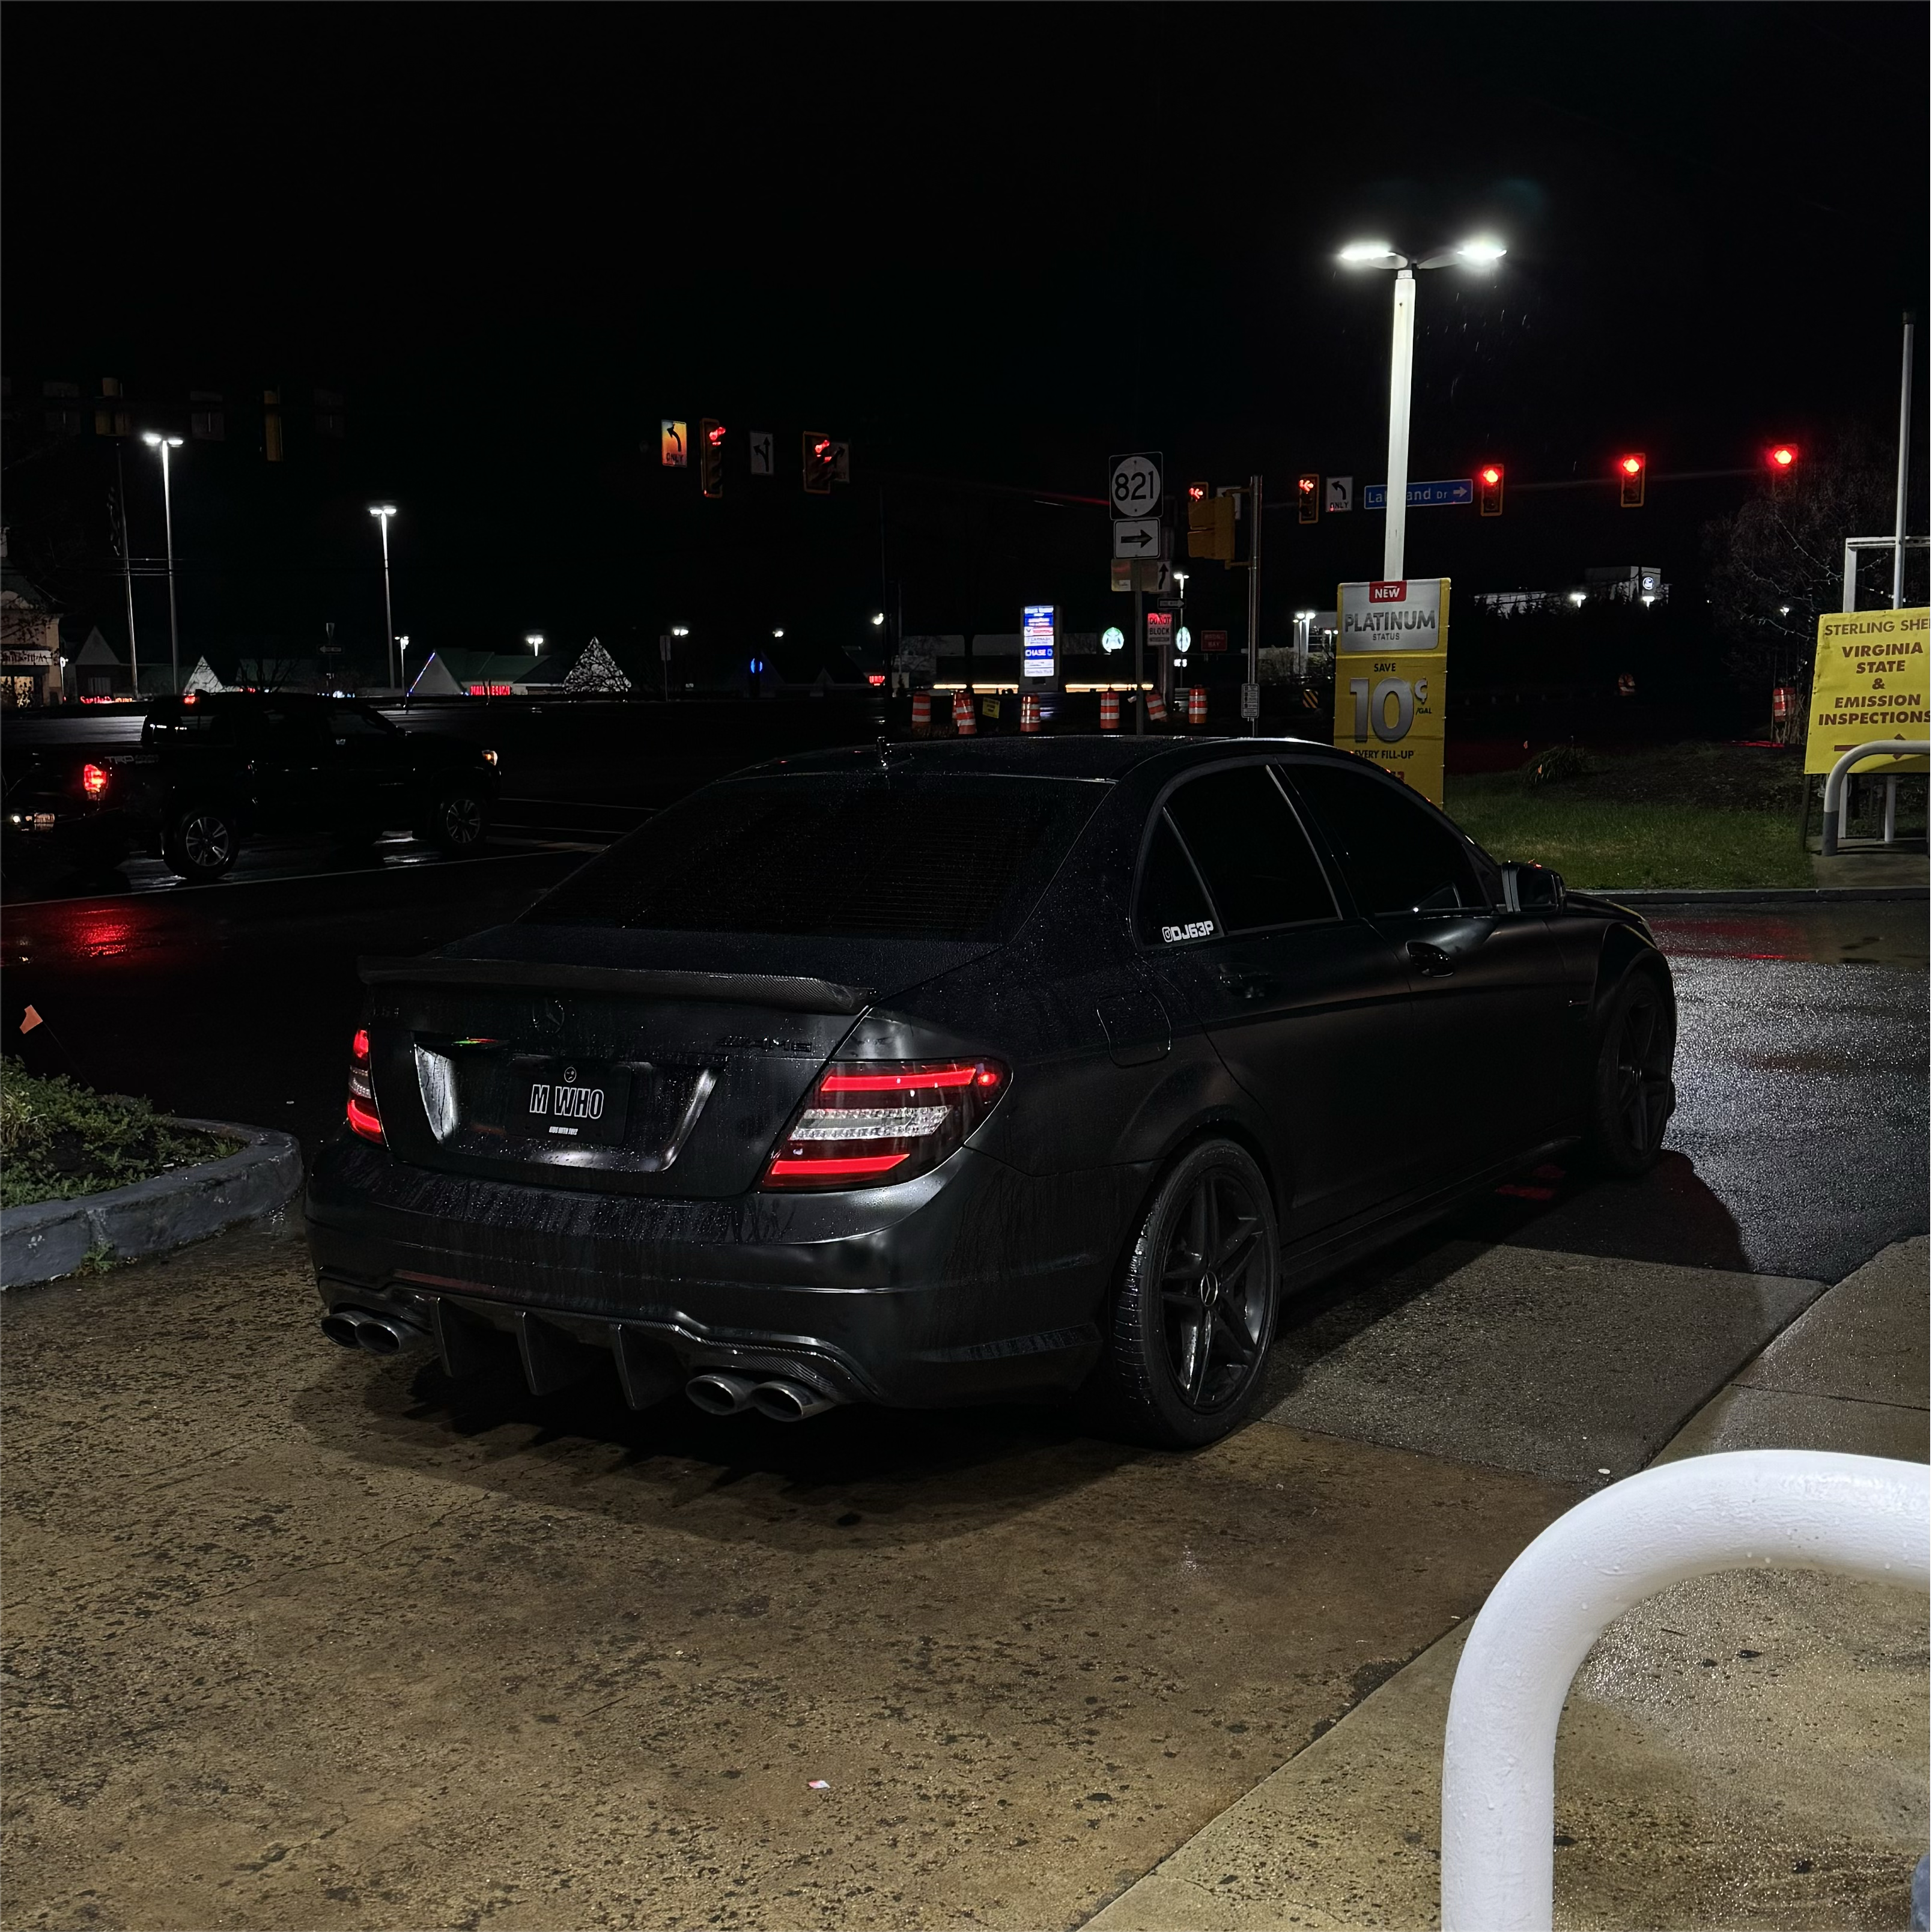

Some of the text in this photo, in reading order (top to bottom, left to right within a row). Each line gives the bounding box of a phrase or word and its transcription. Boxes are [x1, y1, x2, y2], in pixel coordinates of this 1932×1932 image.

[666, 452, 684, 463] ONLY
[1115, 470, 1153, 502] 821
[1368, 487, 1448, 503] Laand Dr
[1375, 586, 1400, 599] NEW
[1344, 610, 1435, 632] PLATINUM
[1824, 618, 1930, 636] STERLING SHE
[1842, 642, 1923, 658] VIRGINIA
[1373, 663, 1396, 672] SAVE
[1856, 660, 1906, 673] STATE
[1872, 678, 1885, 690] &
[1834, 694, 1921, 708] EMISSION
[1818, 710, 1930, 726] INSPECTIONS
[1381, 750, 1414, 759] FILL-UP
[529, 1084, 604, 1119] M WHO
